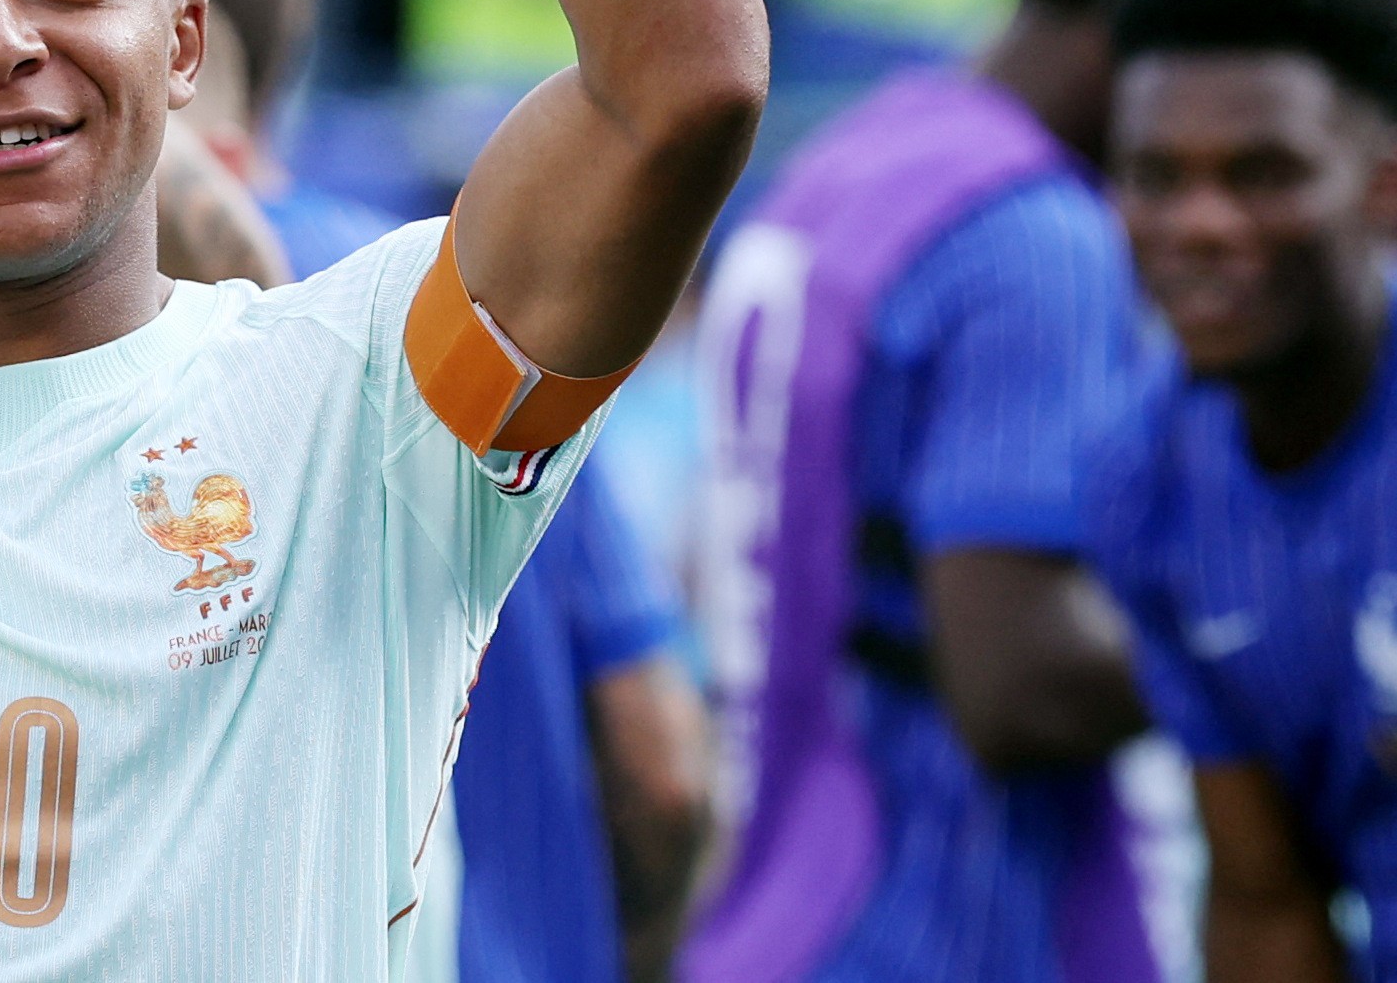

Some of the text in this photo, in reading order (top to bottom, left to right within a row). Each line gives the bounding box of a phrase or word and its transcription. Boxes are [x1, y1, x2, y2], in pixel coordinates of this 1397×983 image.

[169, 624, 224, 650] FRANCE
[168, 650, 193, 670] 09
[200, 639, 241, 667] JUILLET
